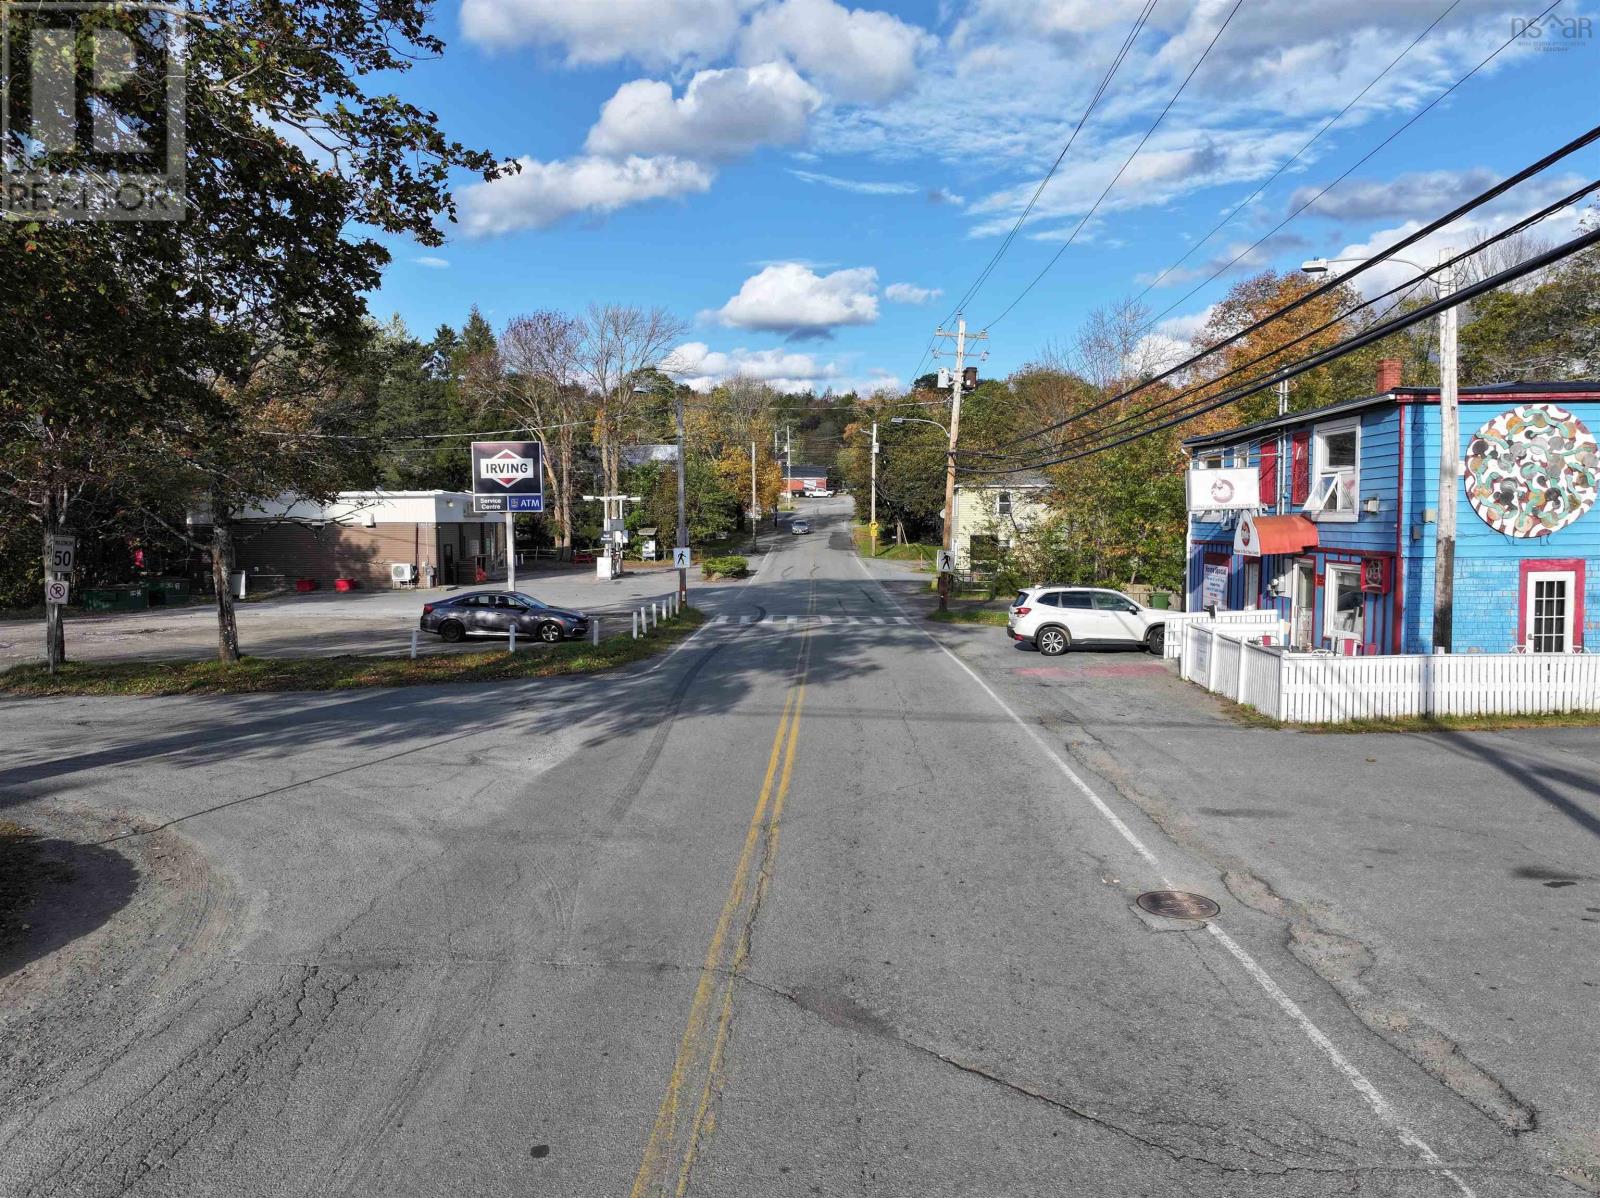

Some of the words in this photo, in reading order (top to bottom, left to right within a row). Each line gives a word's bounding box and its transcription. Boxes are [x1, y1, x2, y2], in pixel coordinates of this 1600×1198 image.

[486, 463, 528, 474] IRVING
[520, 499, 540, 507] ATM
[54, 551, 71, 566] 50
